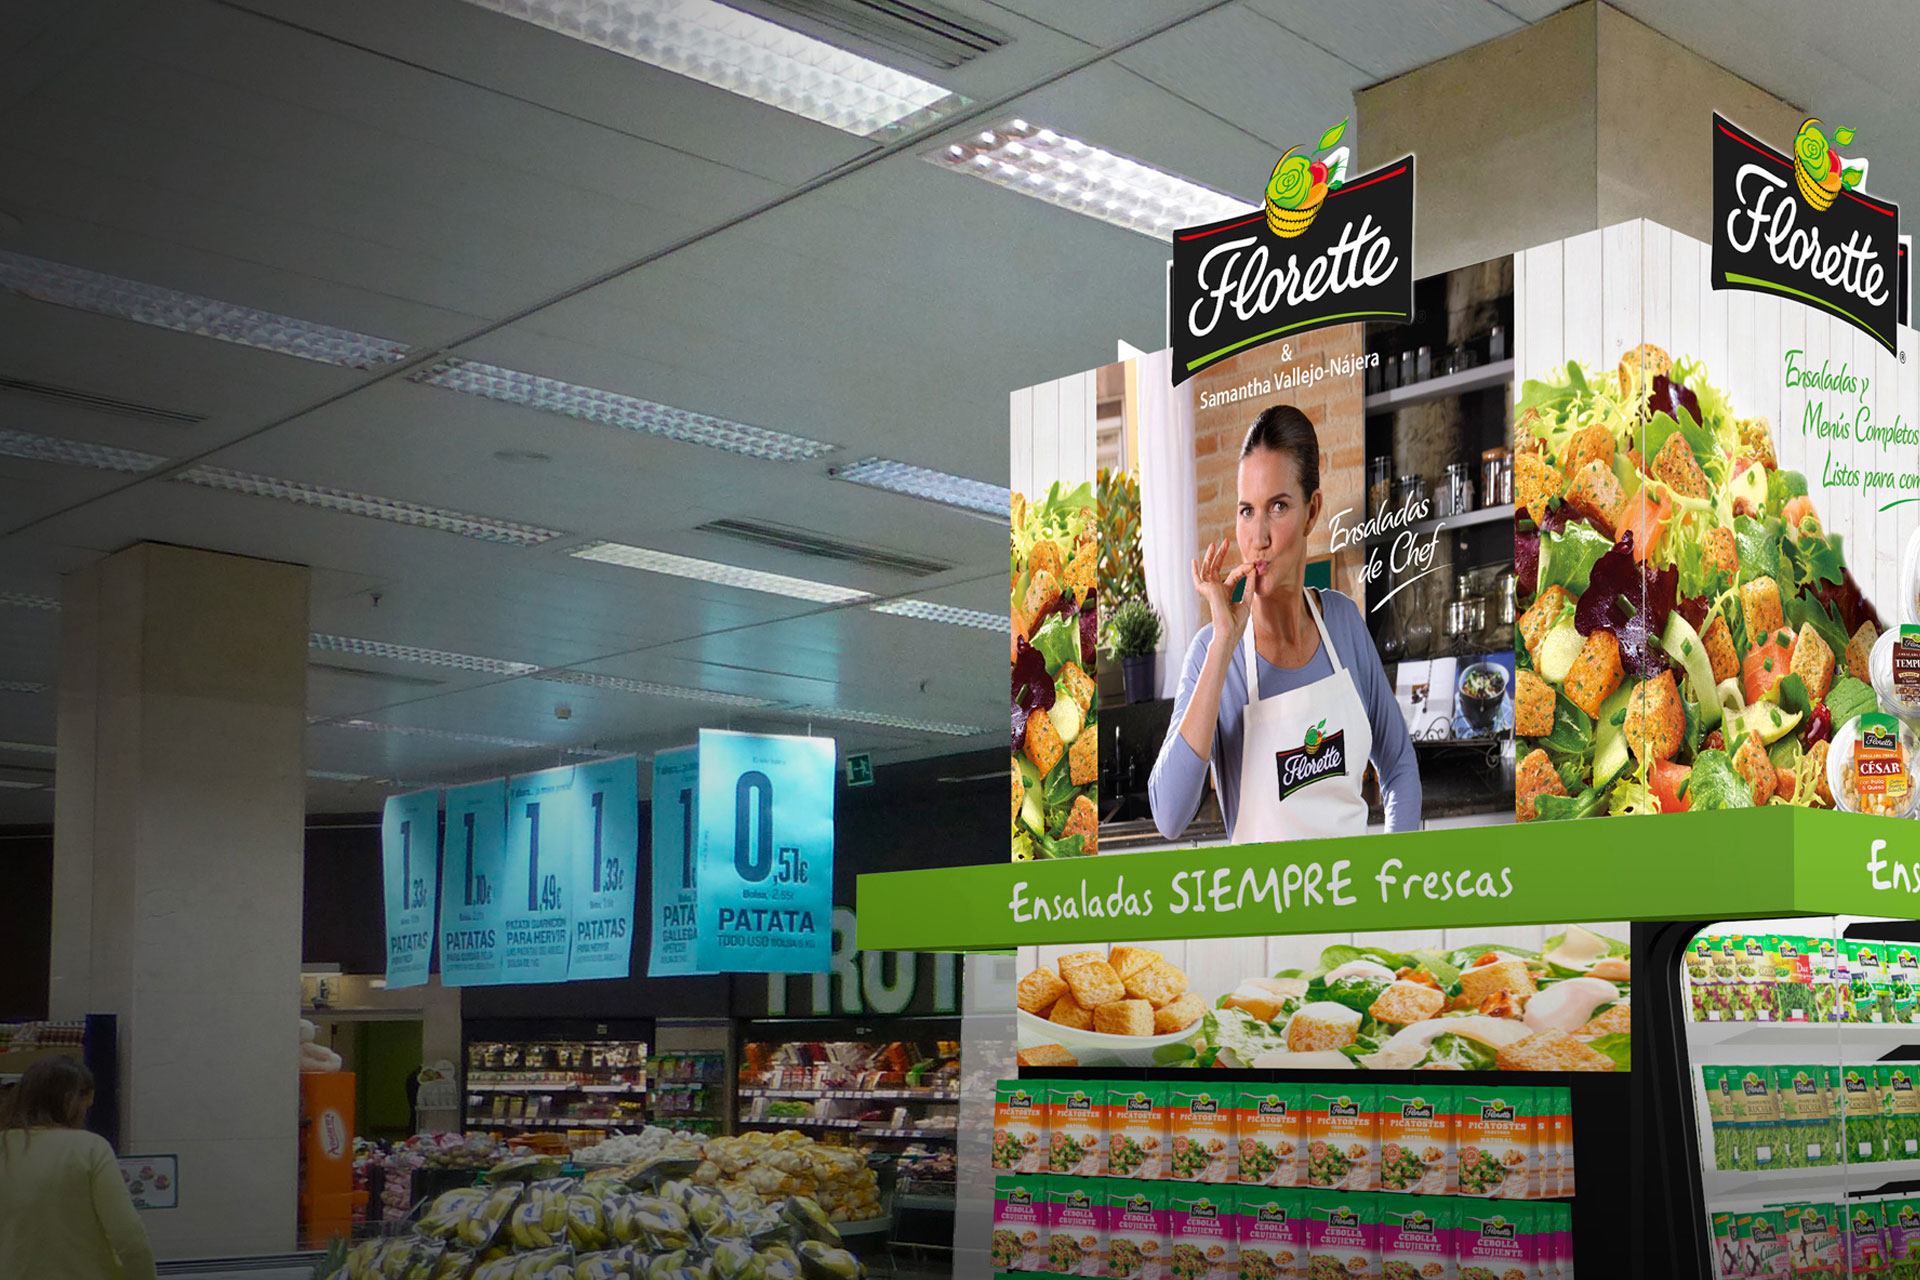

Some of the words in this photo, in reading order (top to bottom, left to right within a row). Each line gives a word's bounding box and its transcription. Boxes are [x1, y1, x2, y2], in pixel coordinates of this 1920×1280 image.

[1727, 163, 1889, 306] Florette
[1188, 214, 1399, 337] Florette
[1281, 343, 1293, 362] &
[1200, 378, 1271, 409] Samantha
[1274, 352, 1380, 389] Vallejo-Nájera
[1785, 349, 1857, 394] Ensaladas
[1861, 377, 1870, 403] y
[1802, 400, 1850, 440] Menús
[1855, 406, 1919, 453] Completos
[1823, 451, 1860, 488] Listos
[1864, 465, 1895, 497] para
[1329, 490, 1430, 553] Ensaladas
[1358, 547, 1383, 584] de
[1390, 522, 1446, 574] Chef
[1283, 745, 1343, 786] Florette
[1860, 761, 1901, 775] CÉSAR
[1009, 875, 1154, 923] Ensaladas
[1170, 859, 1357, 913] SIEMPRE
[1375, 858, 1513, 903] frescas
[578, 917, 626, 940] PATATAS
[718, 908, 815, 933] PATATA
[391, 932, 429, 952] PATATAS
[446, 930, 496, 950] PATATAS
[507, 932, 532, 945] PARA
[1390, 1119, 1445, 1128] PICATOSTES
[1468, 1121, 1527, 1131] PICATOSTES
[1398, 1233, 1438, 1243] CEBOLLA
[1477, 1239, 1519, 1249] CEBOLLA
